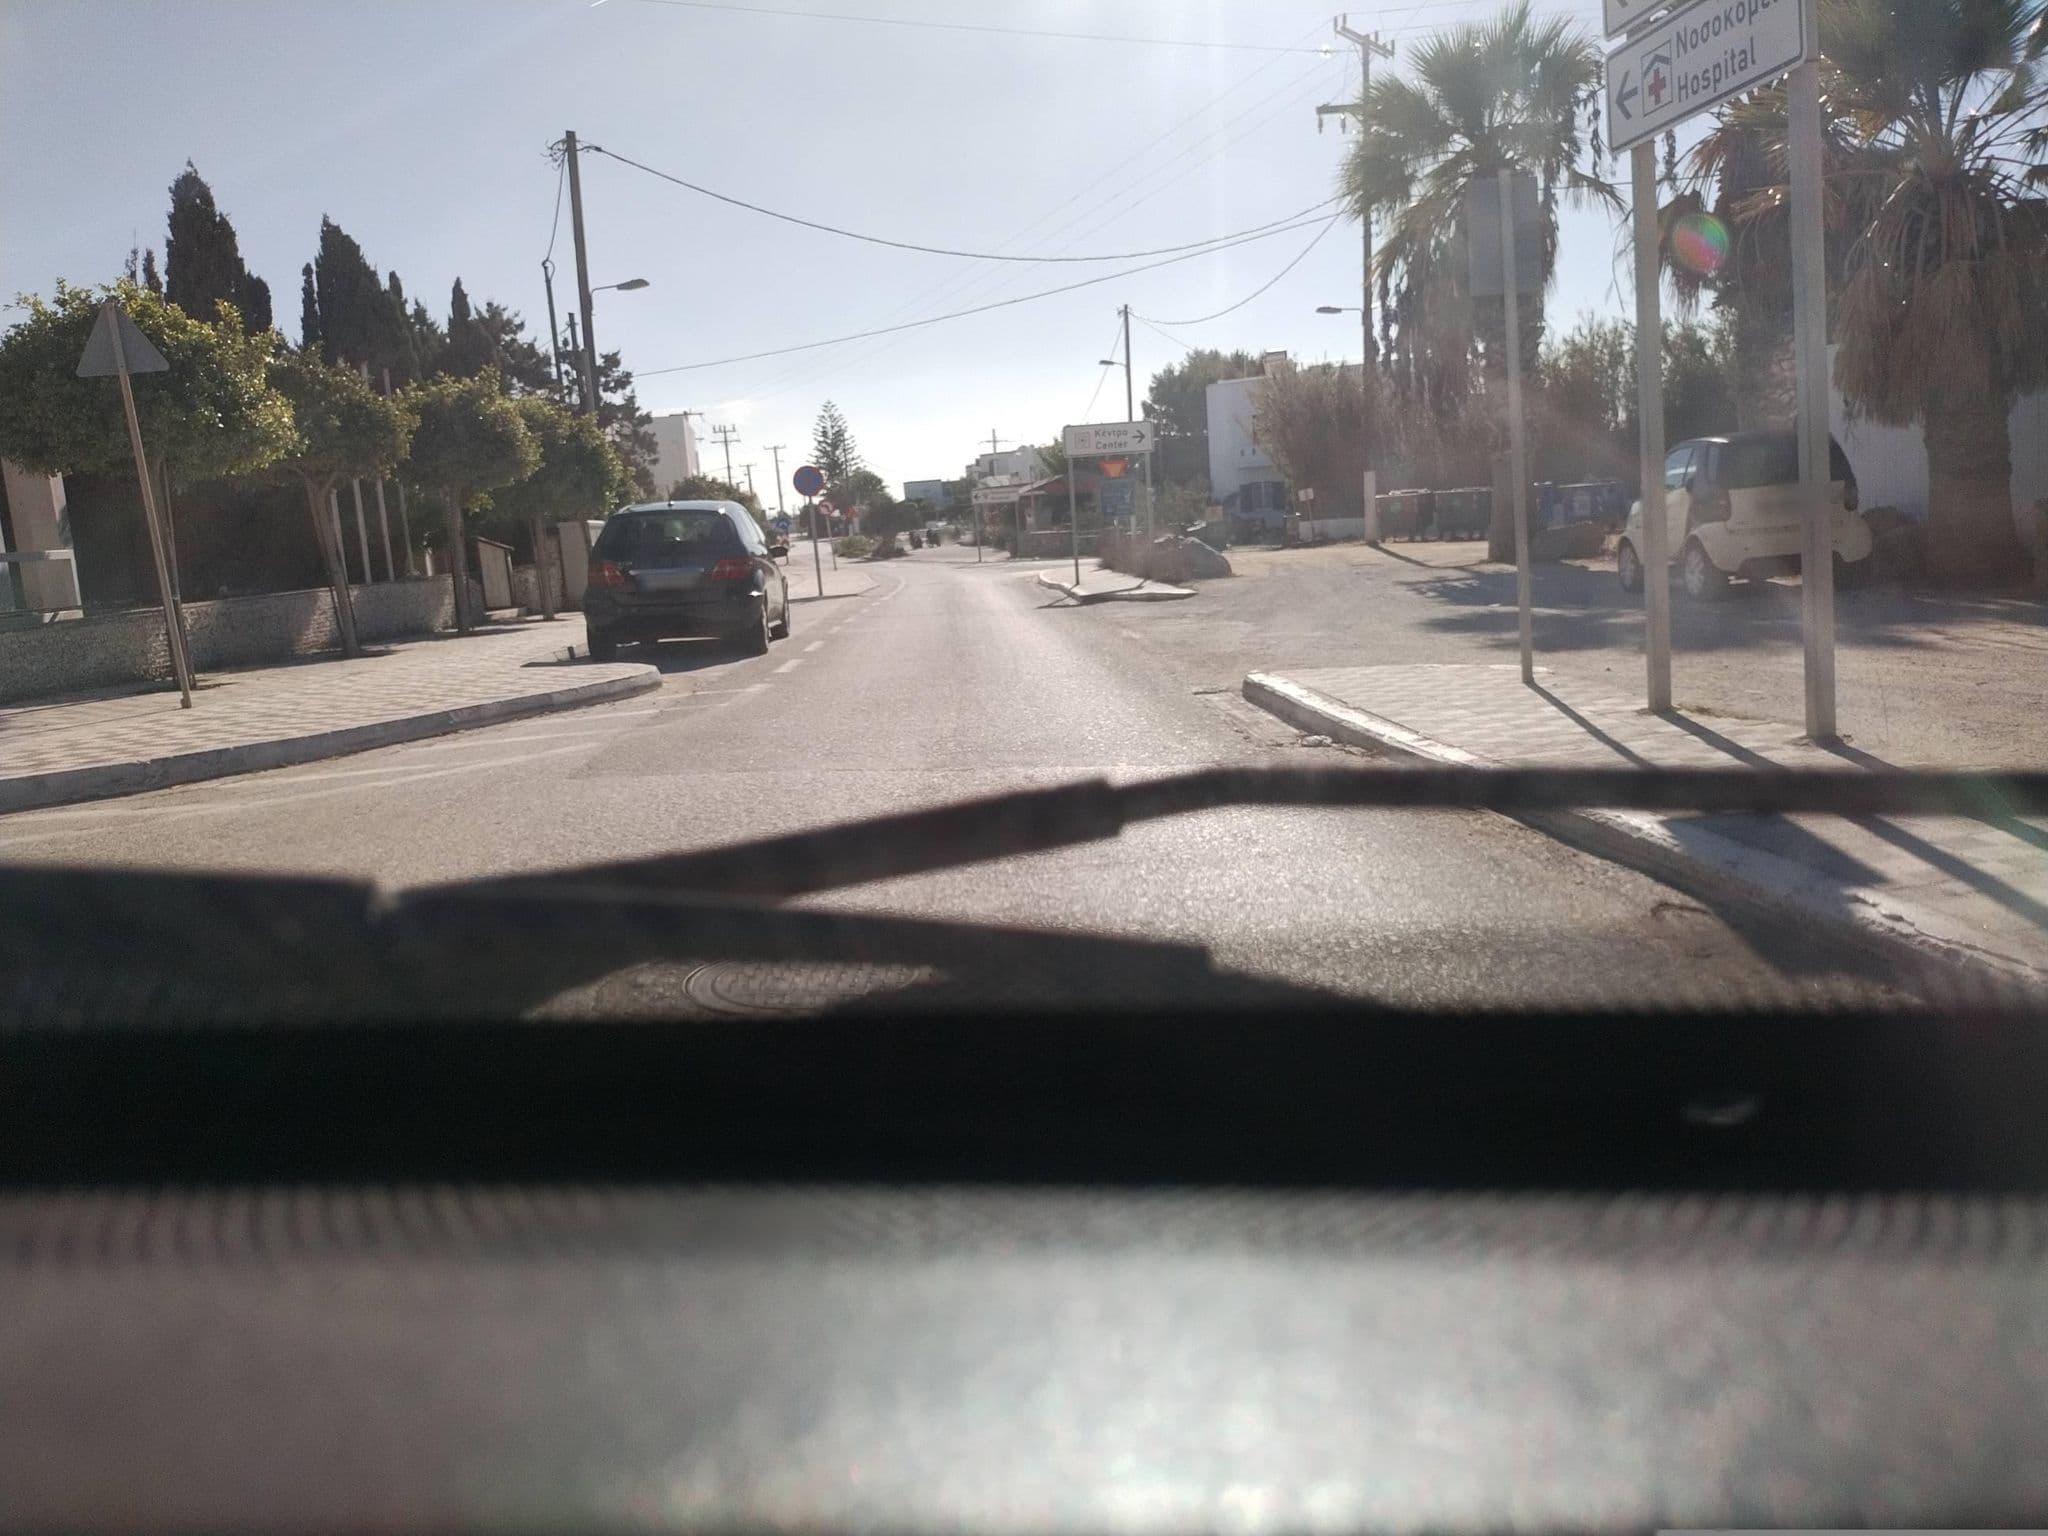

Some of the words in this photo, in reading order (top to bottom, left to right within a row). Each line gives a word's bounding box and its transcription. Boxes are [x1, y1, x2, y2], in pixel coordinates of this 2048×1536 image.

[1676, 0, 1778, 58] Νοσοκομ
[1677, 36, 1756, 102] Hospital
[1095, 441, 1128, 450] Center
